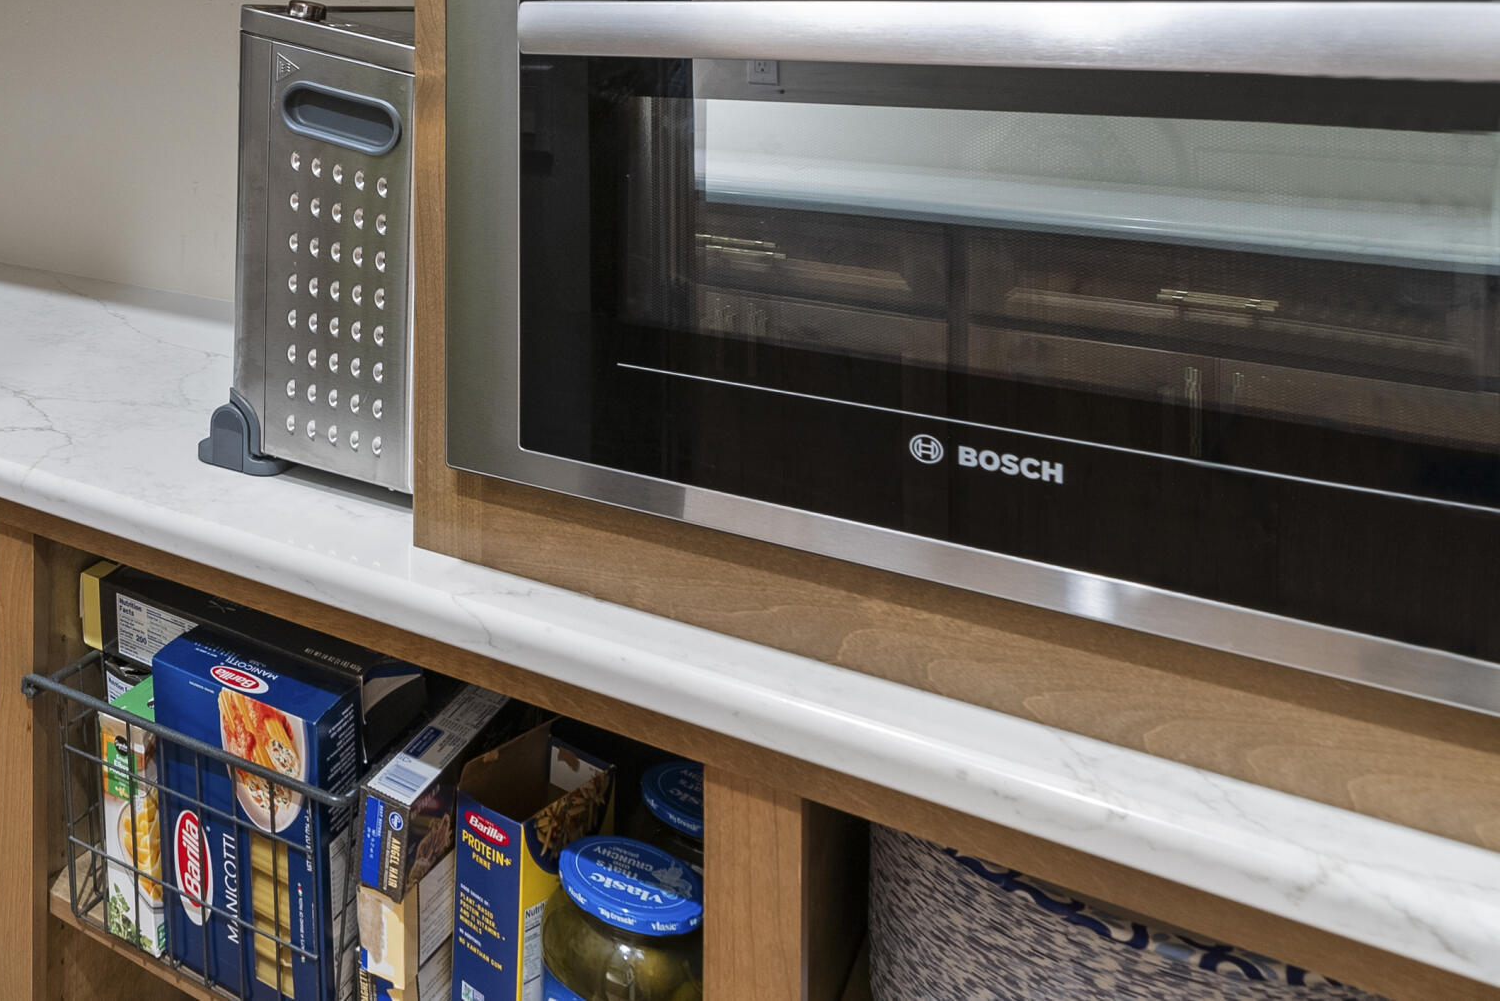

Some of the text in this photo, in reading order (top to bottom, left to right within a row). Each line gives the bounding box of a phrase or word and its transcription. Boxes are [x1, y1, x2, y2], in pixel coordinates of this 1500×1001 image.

[957, 444, 1064, 485] BOSCH
[119, 597, 142, 611] Nutrition
[119, 605, 135, 616] Facts
[135, 634, 148, 645] 200
[214, 667, 256, 689] Barilla
[225, 655, 279, 681] MANICOTTI
[468, 813, 505, 843] Barilla
[181, 818, 202, 900] Barilla
[387, 836, 402, 889] ANGEL HAIR
[471, 851, 492, 871] PENNE
[593, 845, 654, 873] CRUNCHY
[595, 857, 639, 881] That's
[222, 832, 241, 945] MANICOTTI
[590, 871, 664, 905] vlasic
[459, 891, 494, 920] PLANT-BASED
[459, 908, 501, 941] AND VITAMINS
[459, 915, 483, 936] MINERALS
[651, 920, 678, 932] vlasic
[458, 937, 503, 972] NO XANTHAN GUM
